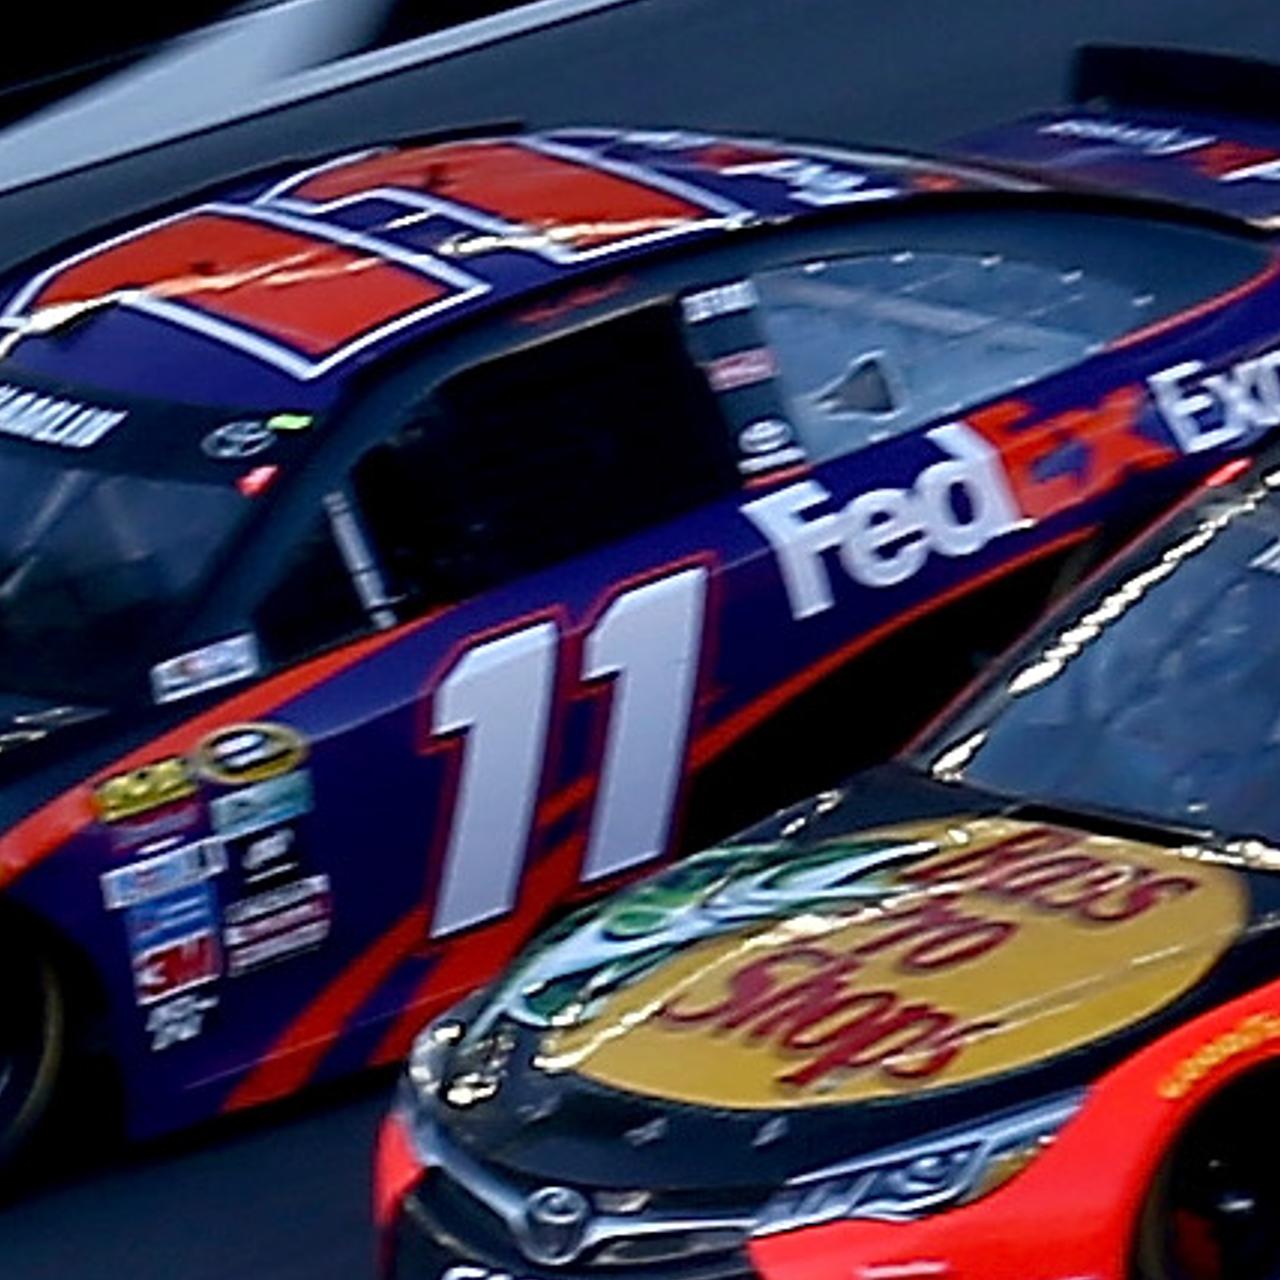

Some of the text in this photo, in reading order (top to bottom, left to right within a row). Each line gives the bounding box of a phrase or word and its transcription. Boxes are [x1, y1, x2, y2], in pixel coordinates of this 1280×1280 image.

[741, 382, 1181, 621] FedEx
[429, 563, 709, 940] 11
[892, 825, 1197, 924] Bass
[658, 946, 1002, 1087] Shops
